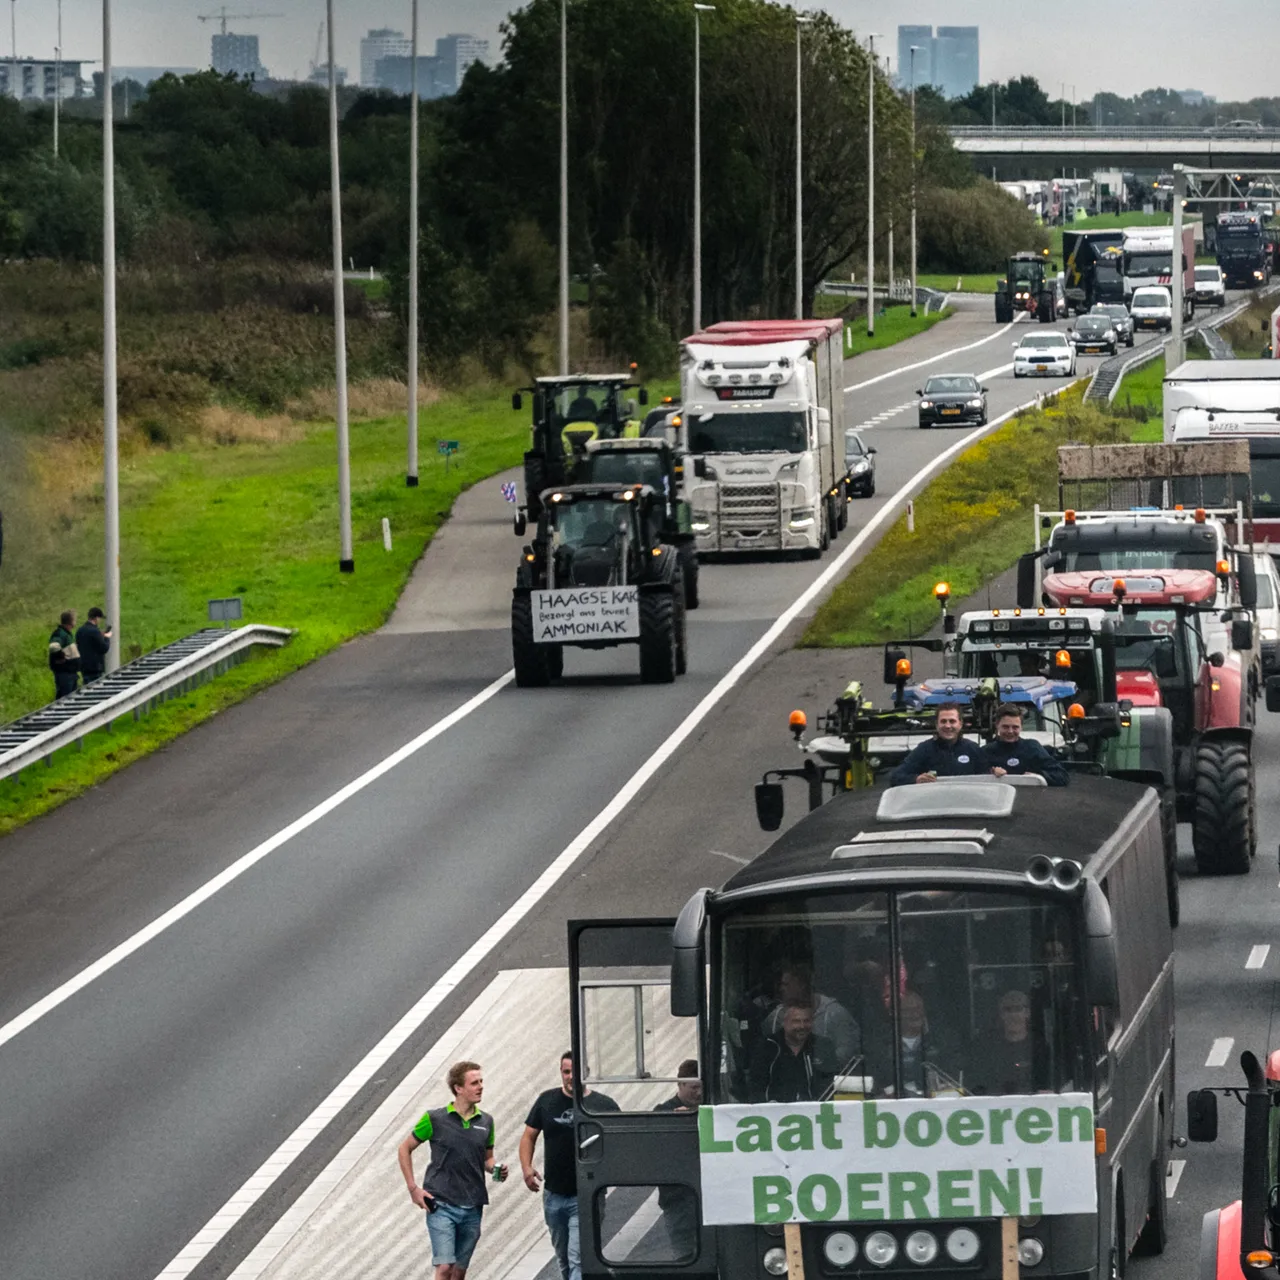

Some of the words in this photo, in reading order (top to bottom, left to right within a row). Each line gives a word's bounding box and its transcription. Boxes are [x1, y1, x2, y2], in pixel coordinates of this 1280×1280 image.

[539, 591, 608, 610] HAAGSE
[541, 620, 627, 639] AMMONIAK
[699, 1102, 843, 1154] Laat
[862, 1100, 1093, 1150] boeren
[752, 1167, 1044, 1224] BOEREN!
